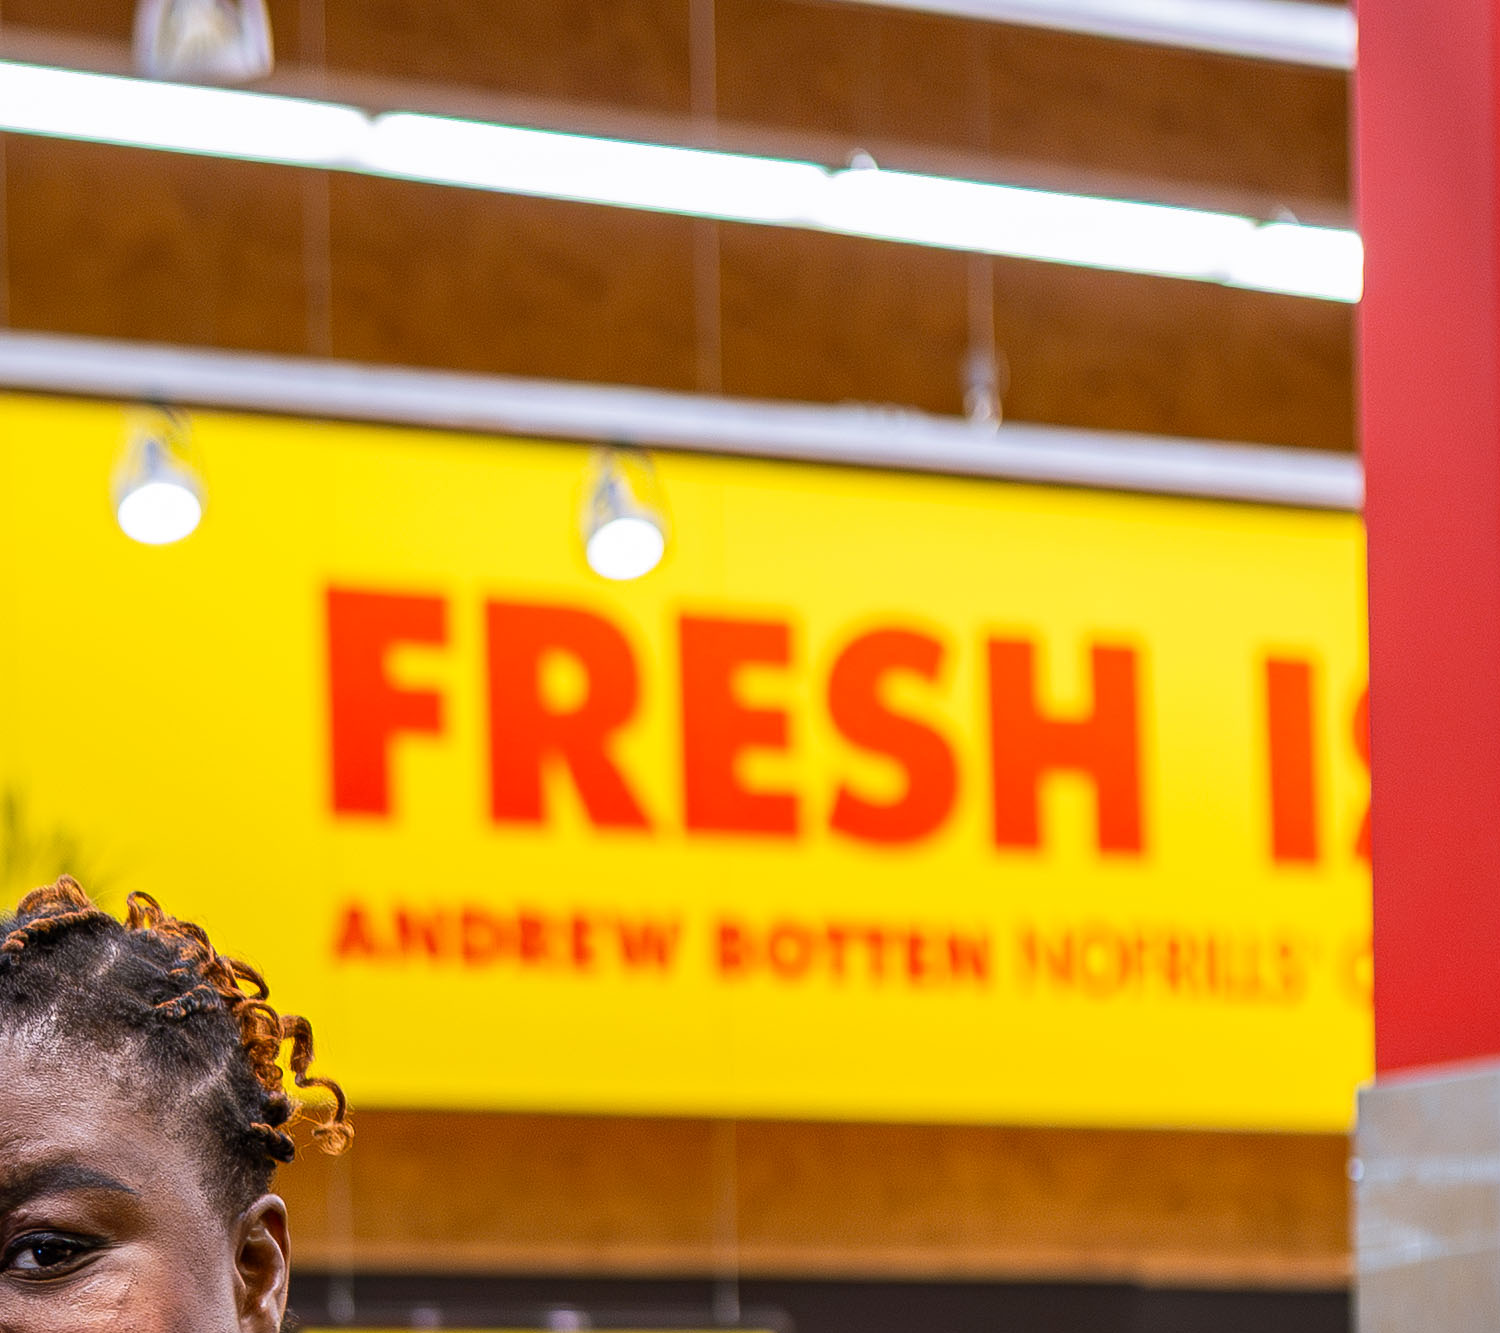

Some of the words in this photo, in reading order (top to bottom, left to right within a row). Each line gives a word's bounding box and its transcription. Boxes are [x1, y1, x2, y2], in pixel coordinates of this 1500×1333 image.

[325, 587, 1144, 860] FRESH
[1264, 657, 1373, 868] I
[331, 905, 683, 977] ANDREW
[718, 915, 990, 990] BOTTEN
